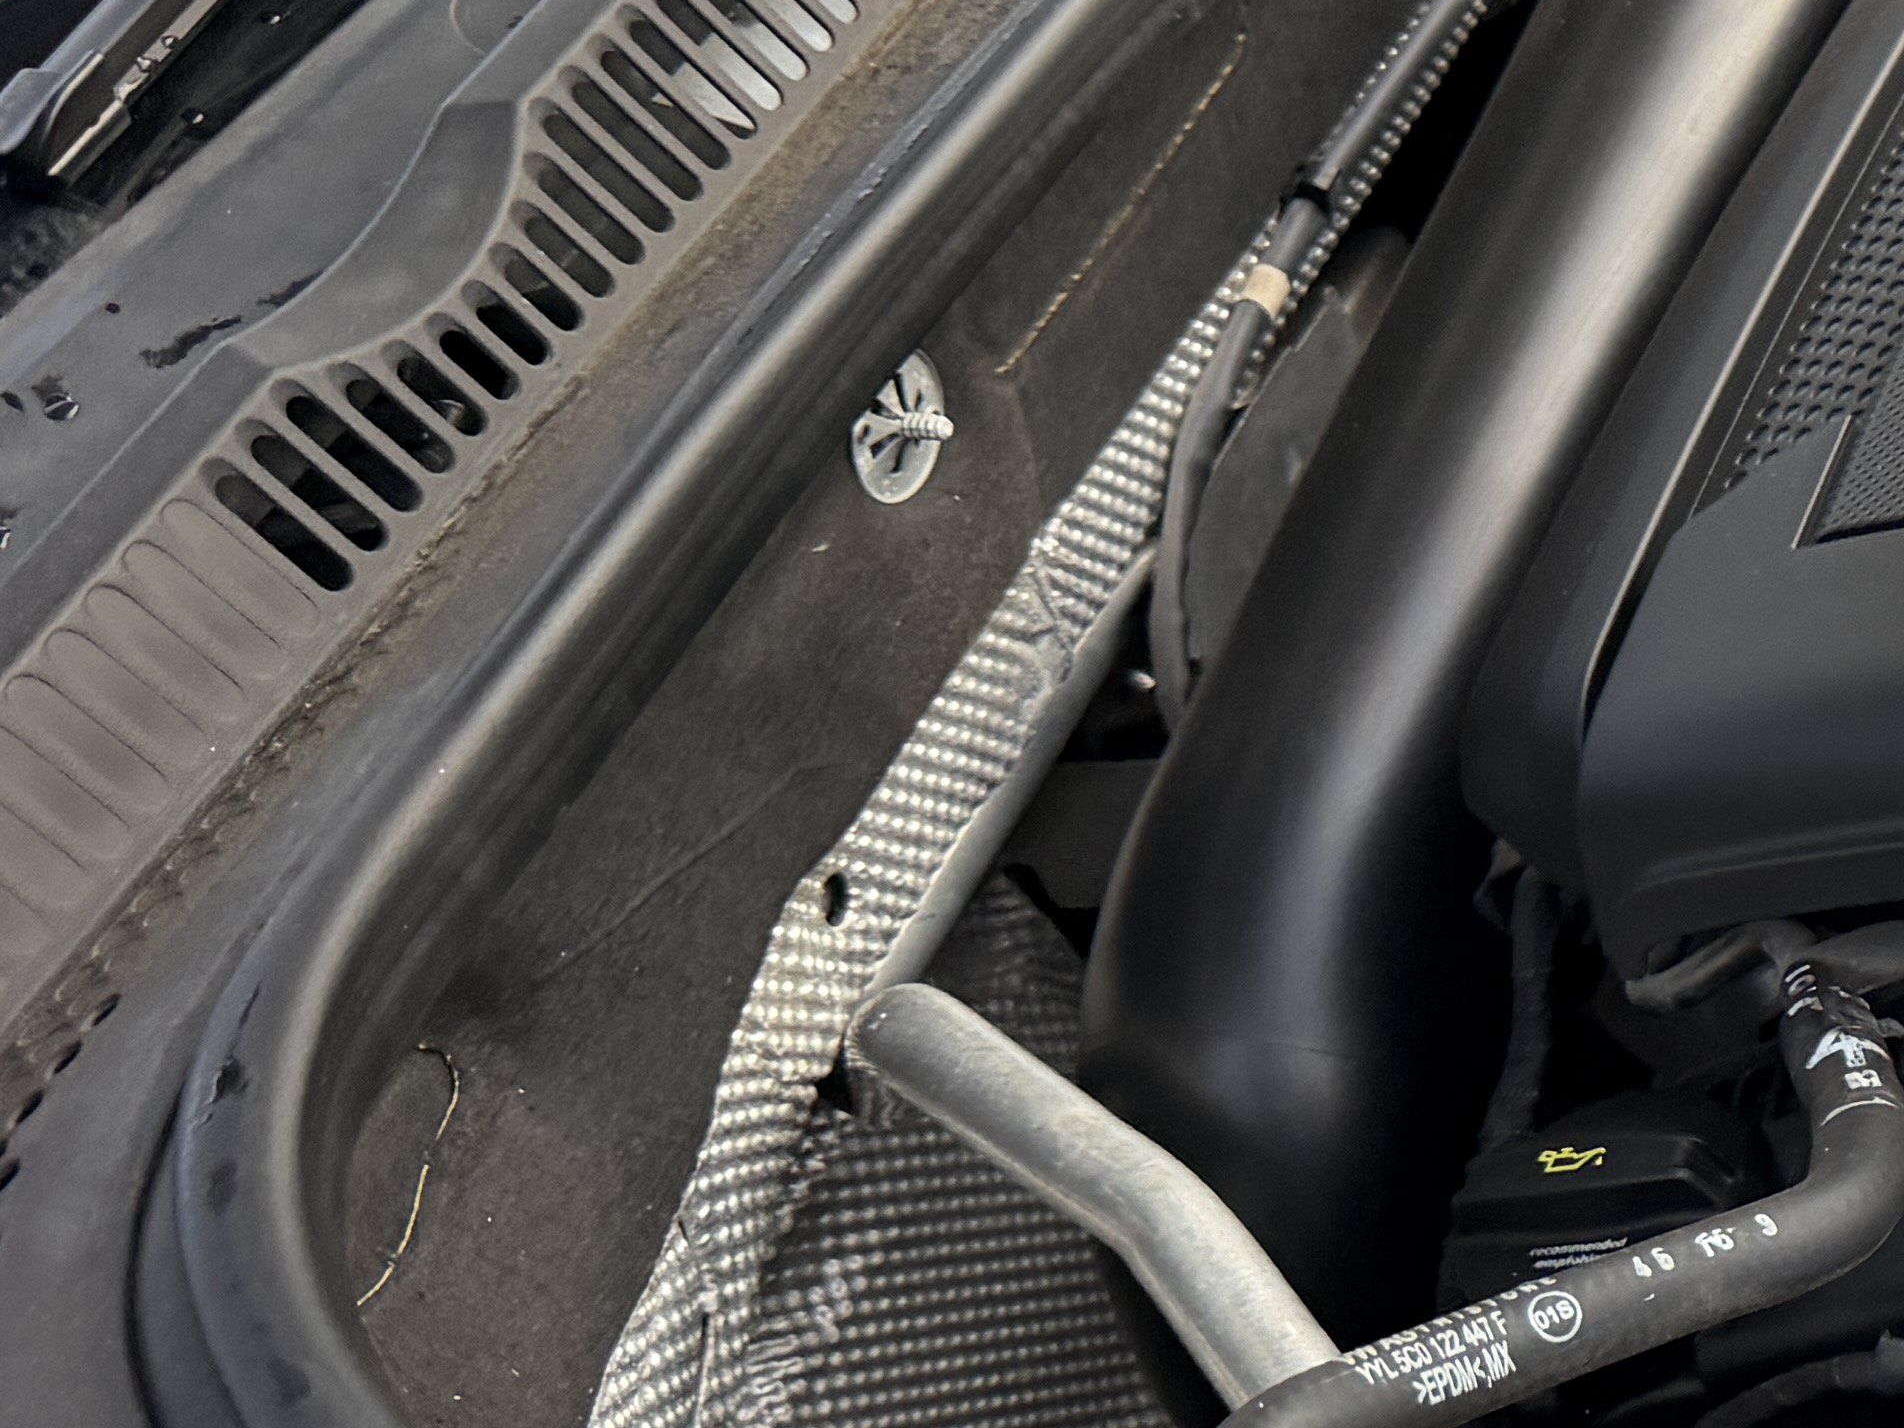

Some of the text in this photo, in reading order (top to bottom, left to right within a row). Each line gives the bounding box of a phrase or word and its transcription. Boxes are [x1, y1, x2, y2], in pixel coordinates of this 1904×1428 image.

[1431, 1328, 1468, 1363] 122
[1464, 1315, 1497, 1354] 447
[1490, 1310, 1510, 1335] F
